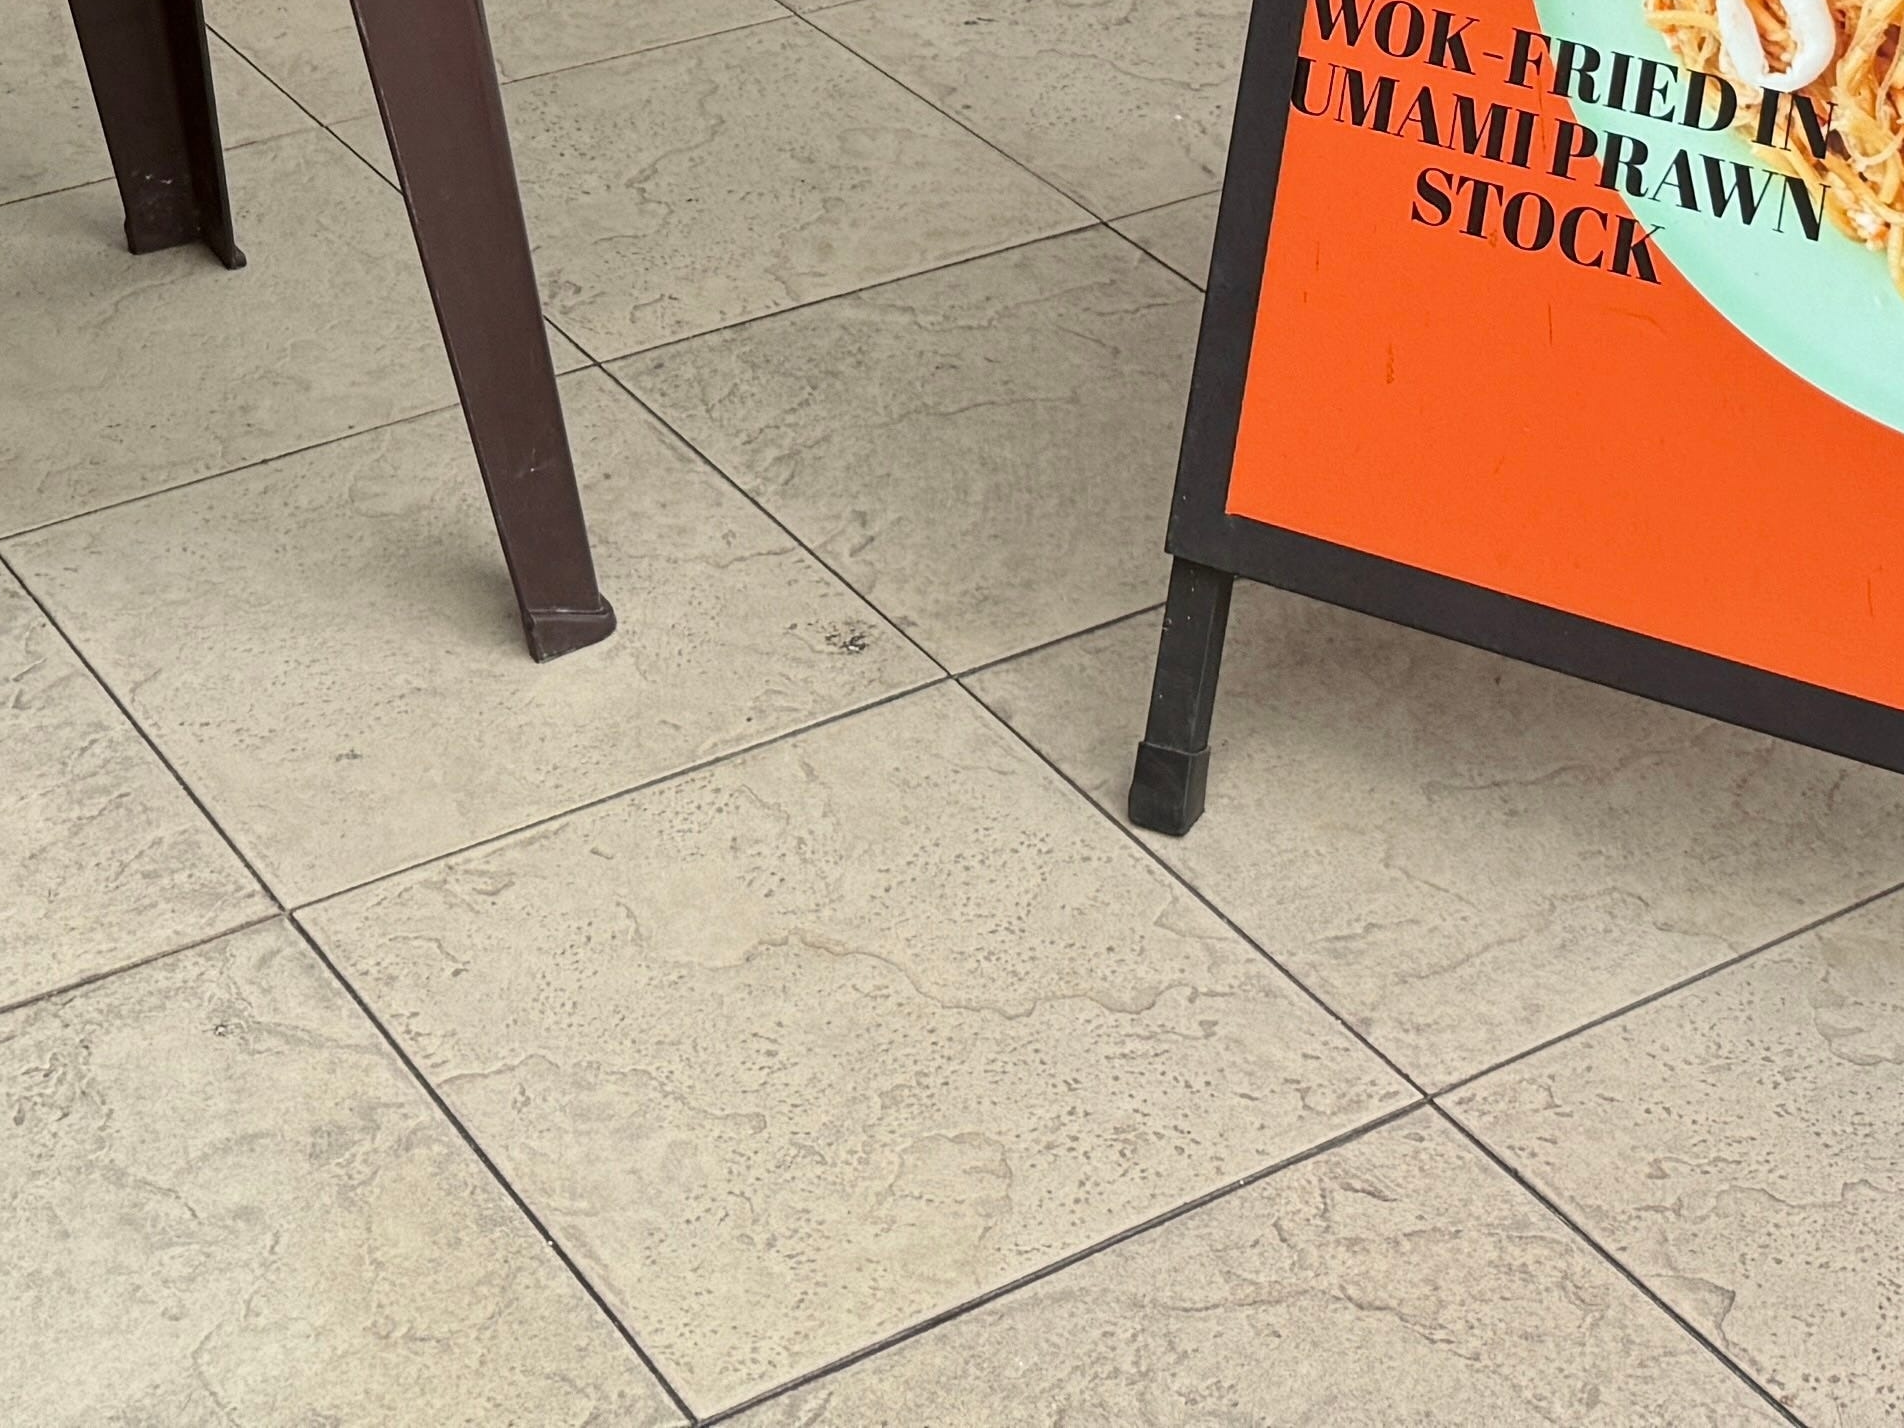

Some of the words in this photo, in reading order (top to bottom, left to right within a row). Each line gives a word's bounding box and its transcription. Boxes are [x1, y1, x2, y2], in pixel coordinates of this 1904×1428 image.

[1290, 55, 1540, 170] UMAMI
[1545, 117, 1831, 242] PRAWN
[1752, 86, 1838, 161] IN
[1410, 166, 1666, 286] STOCK
